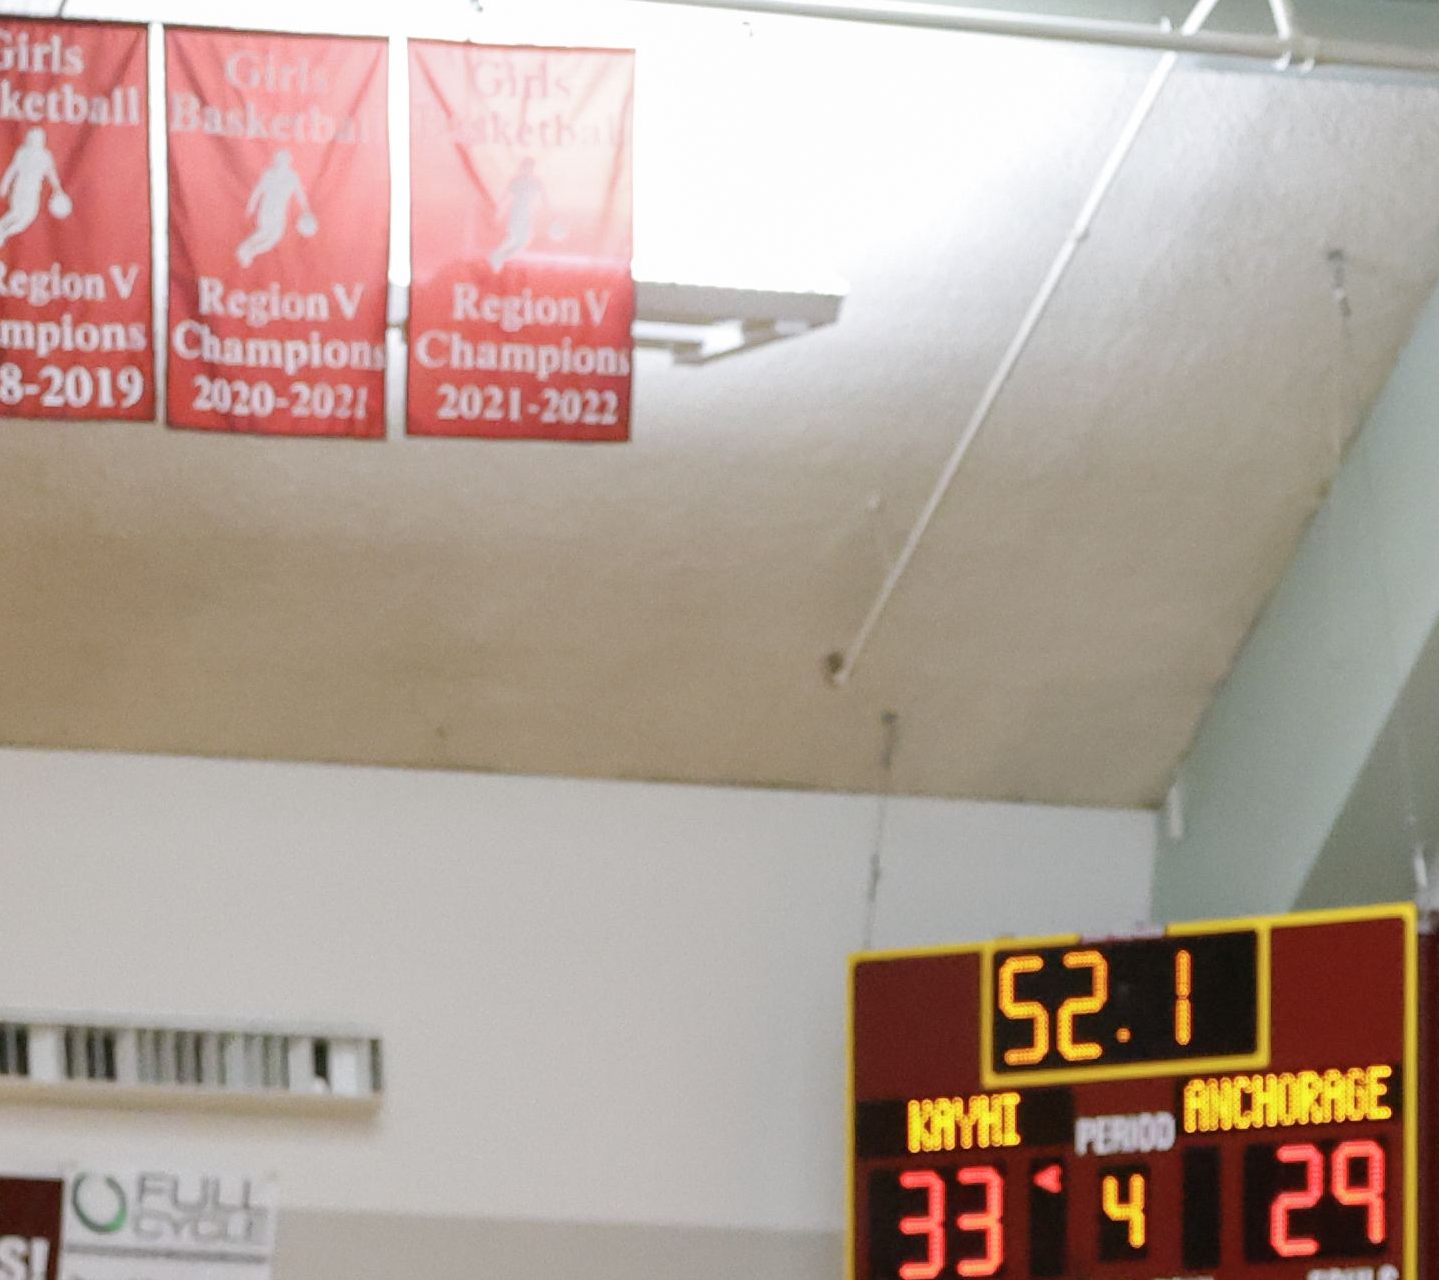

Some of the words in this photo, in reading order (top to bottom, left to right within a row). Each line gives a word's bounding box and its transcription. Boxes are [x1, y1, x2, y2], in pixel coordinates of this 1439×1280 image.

[224, 50, 329, 94] Girls
[470, 58, 572, 101] Girls
[109, 264, 138, 298] V
[198, 276, 330, 327] Region
[332, 282, 364, 321] V
[454, 283, 583, 333] Region
[587, 290, 610, 327] V
[171, 319, 385, 375] Champions
[415, 328, 630, 380] Champions
[192, 374, 368, 420] 2020-2021
[436, 384, 619, 424] 2021-2022
[999, 949, 1191, 1066] 52.1
[907, 1091, 1021, 1153] KAYHI
[1183, 1065, 1393, 1133] ANCHORAGE
[1074, 1110, 1177, 1157] PERIOD
[137, 1172, 268, 1217] FULL
[1102, 1174, 1146, 1249] 4
[1268, 1141, 1385, 1258] 29
